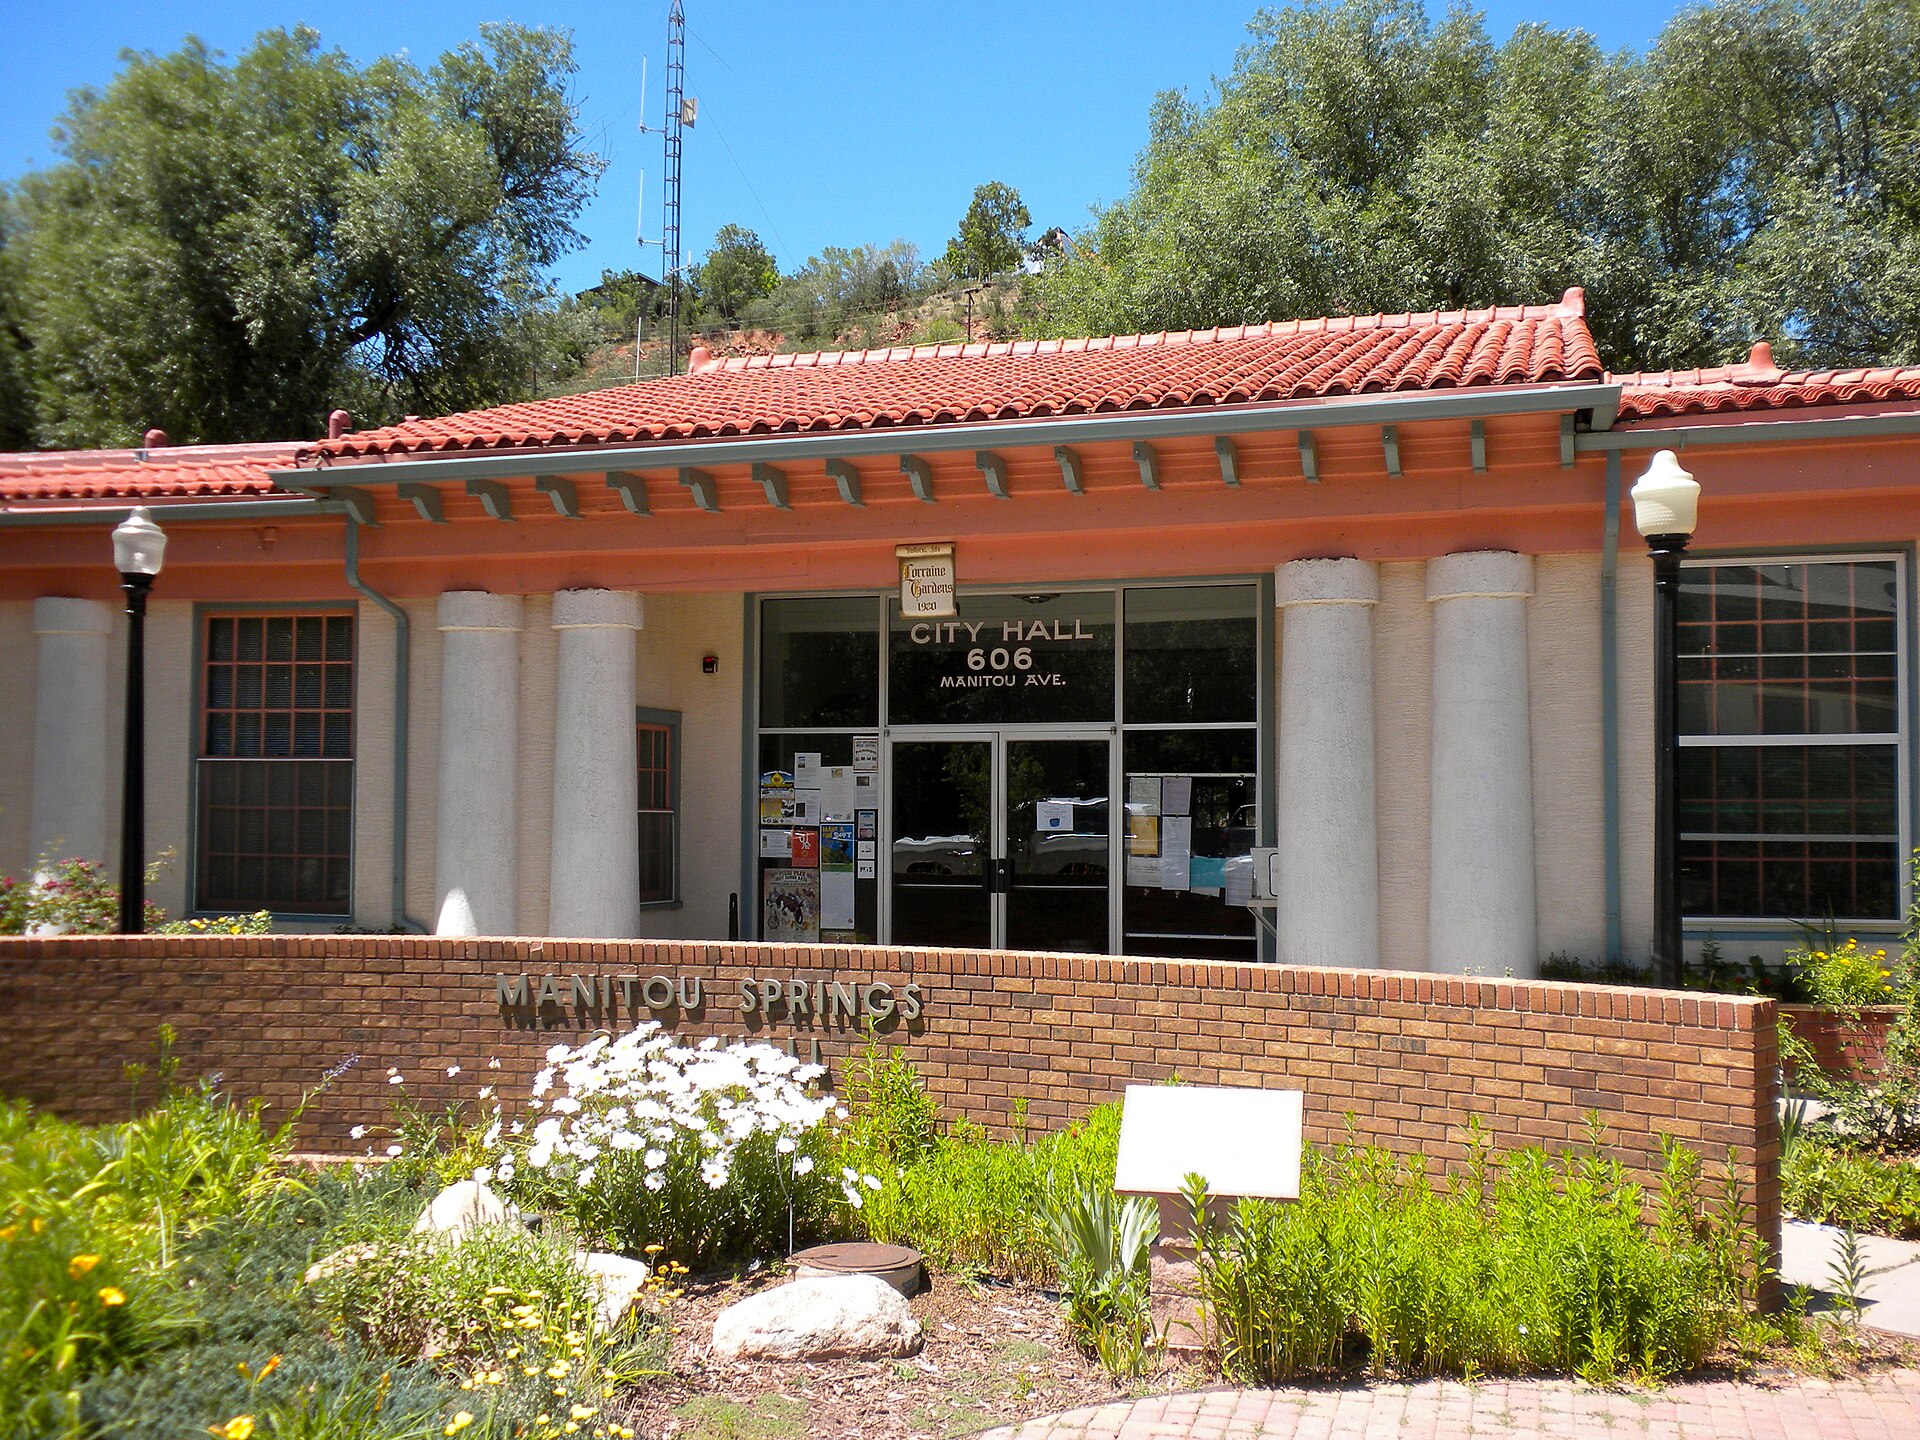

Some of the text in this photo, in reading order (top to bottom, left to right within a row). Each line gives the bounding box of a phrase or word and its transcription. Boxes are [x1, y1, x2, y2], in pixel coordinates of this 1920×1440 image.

[903, 563, 946, 582] Lorraine
[909, 579, 954, 600] Gardens
[910, 618, 1094, 644] CITY HALL
[967, 647, 1033, 671] 606
[940, 674, 1067, 688] MANITOU AVE.
[496, 972, 921, 1020] MANITOU SPRINGS
